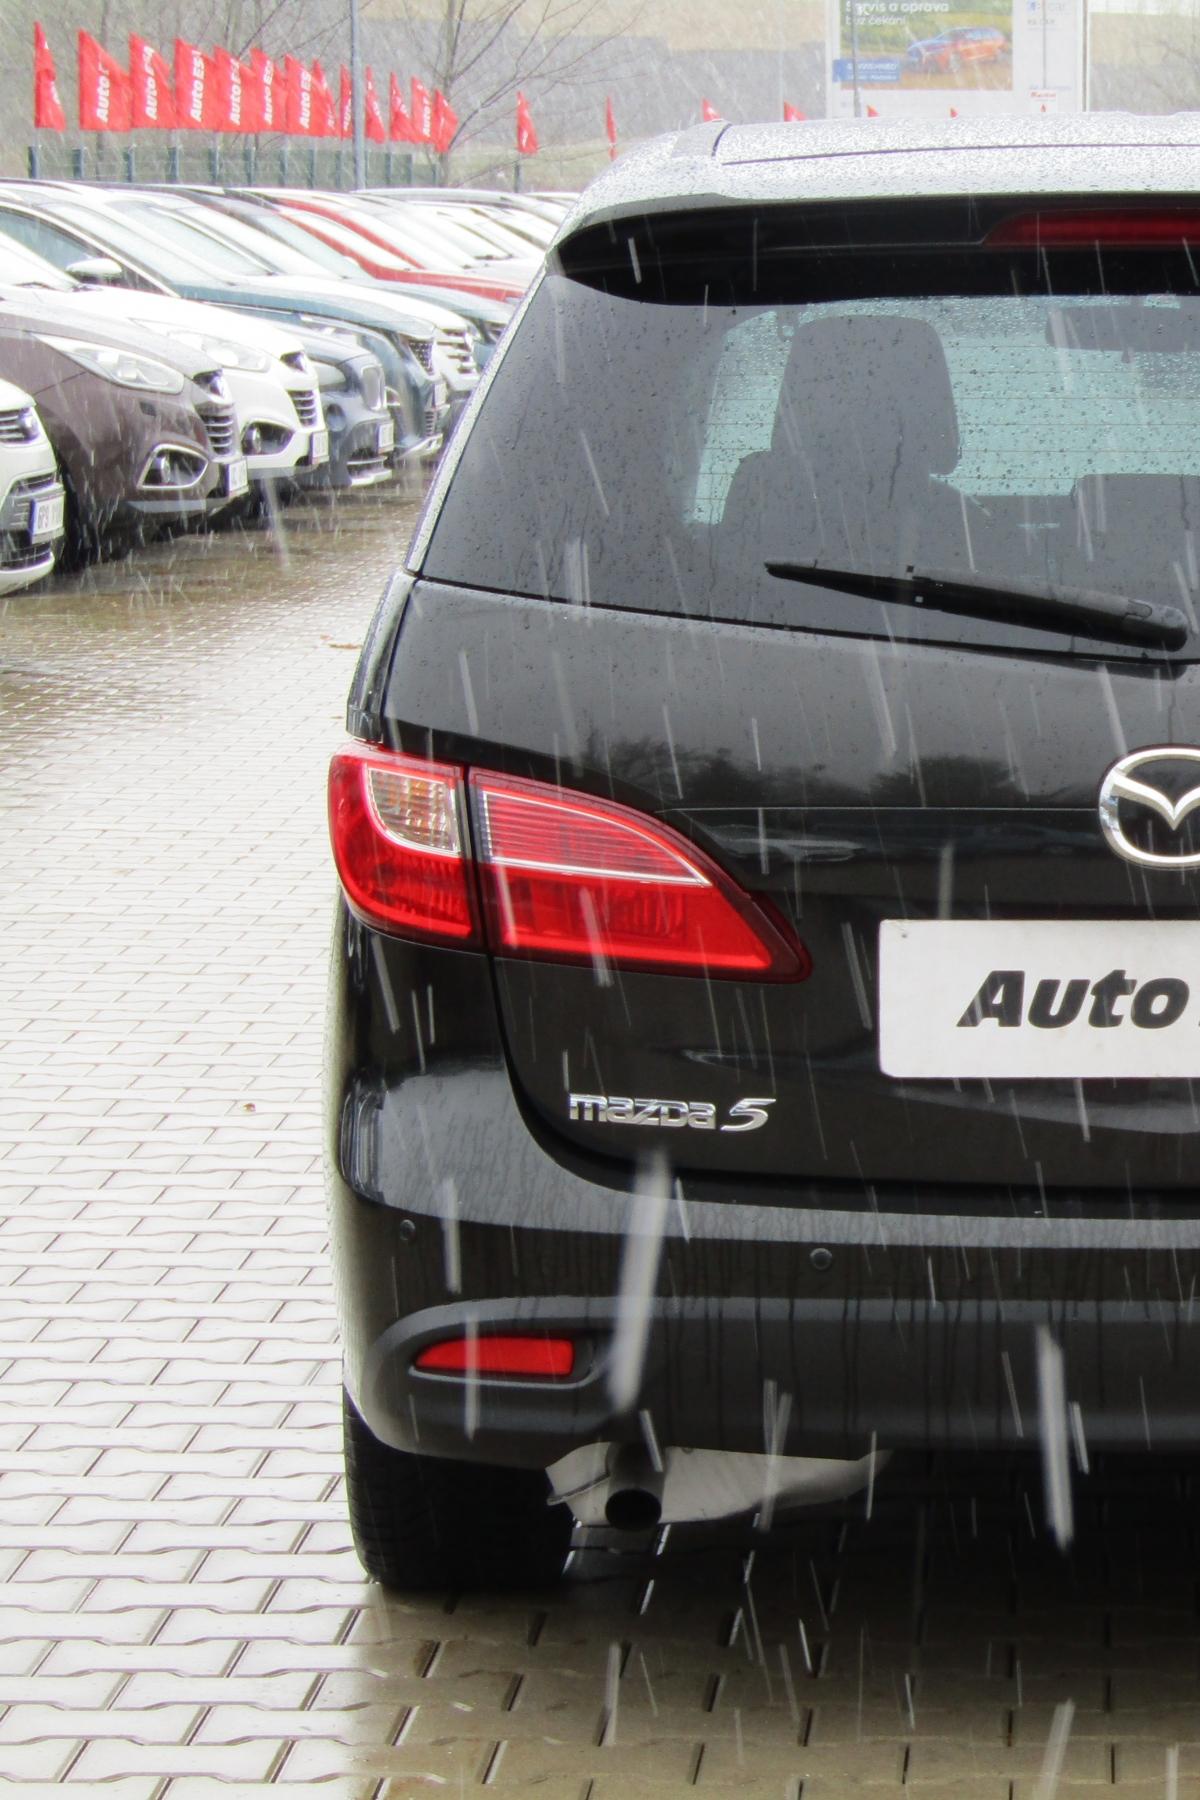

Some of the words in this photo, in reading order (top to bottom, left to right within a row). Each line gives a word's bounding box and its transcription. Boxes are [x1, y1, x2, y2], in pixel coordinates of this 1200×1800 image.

[901, 2, 950, 14] oprava
[145, 76, 158, 120] Auto
[190, 80, 204, 122] Auto
[229, 83, 242, 126] Auto
[299, 91, 311, 128] Auto
[956, 969, 1190, 1029] Auto
[720, 1097, 777, 1132] 5
